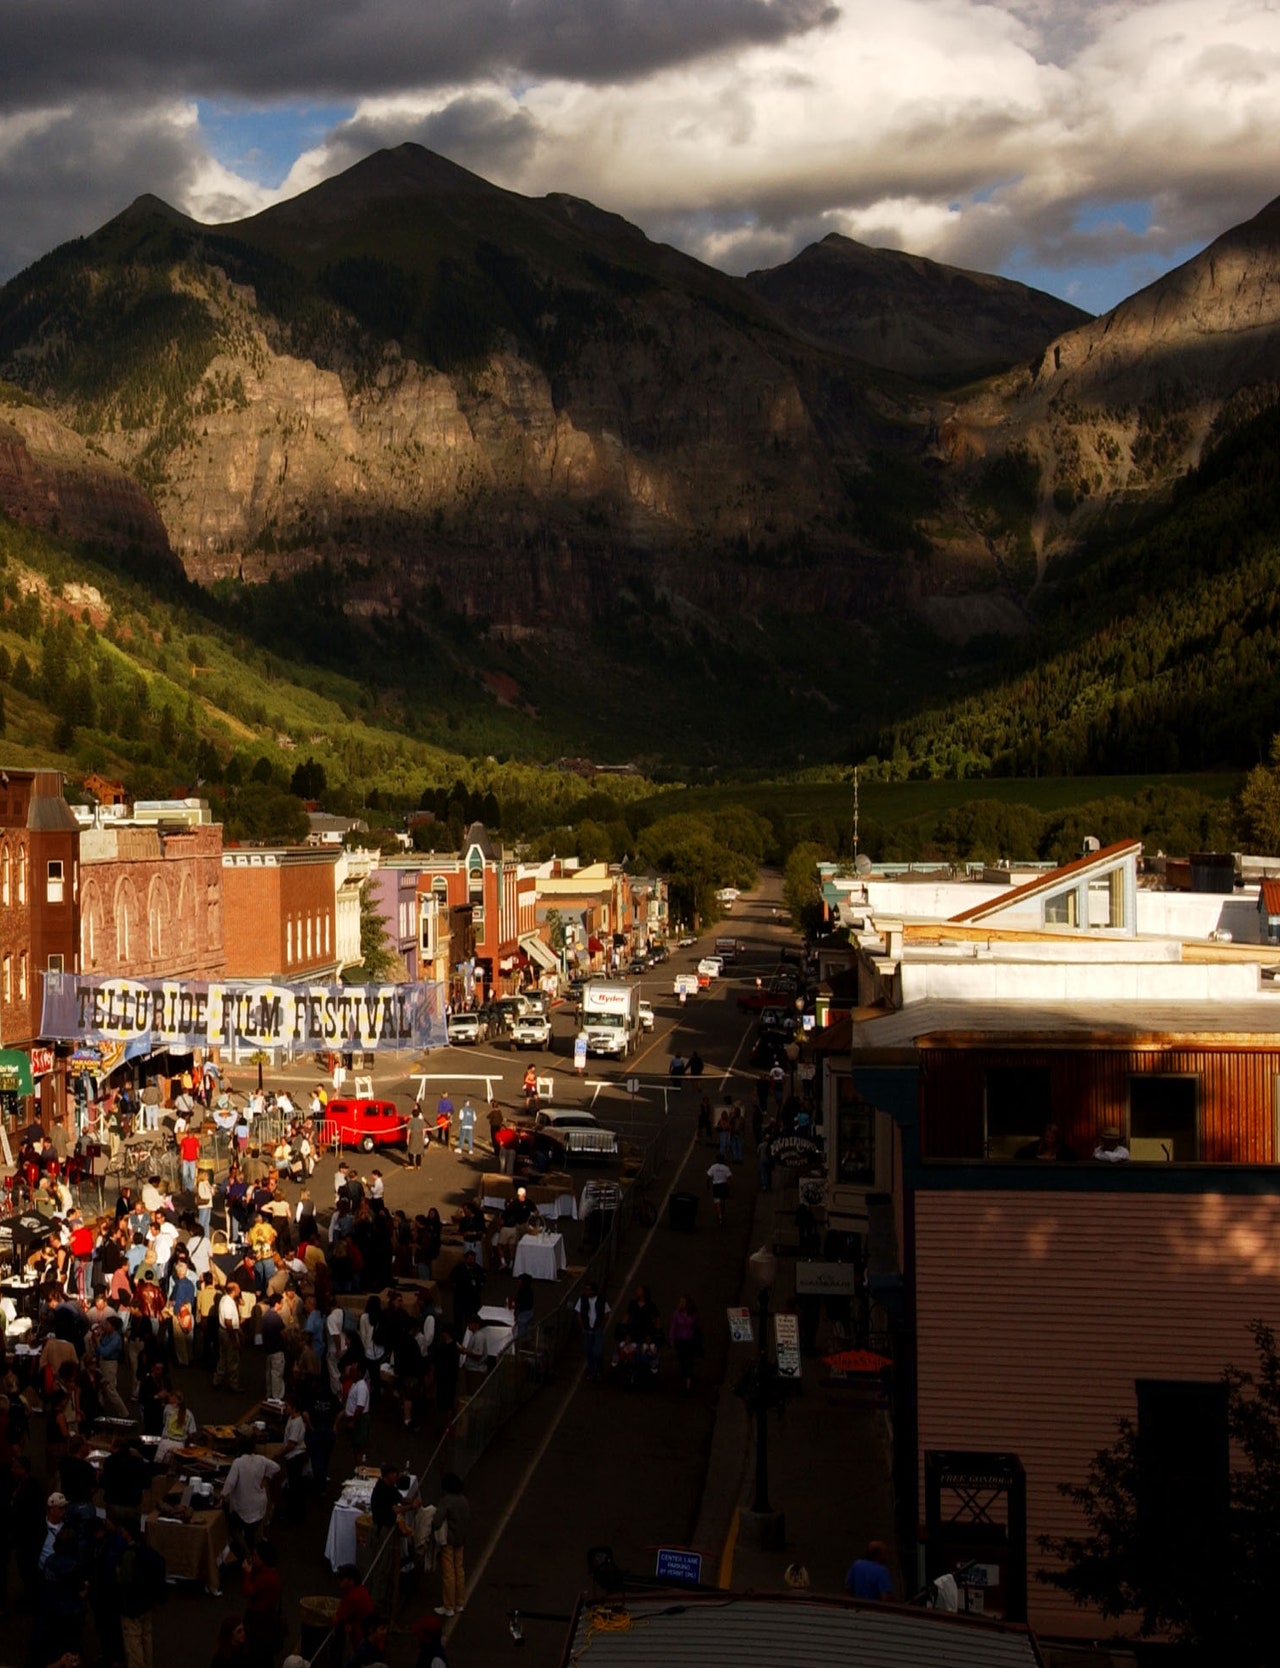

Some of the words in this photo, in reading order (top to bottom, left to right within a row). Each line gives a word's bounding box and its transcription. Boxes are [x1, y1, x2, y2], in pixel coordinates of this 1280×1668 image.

[76, 985, 209, 1036] TELLURIDE
[219, 993, 281, 1037] FILM
[293, 989, 413, 1039] FESTIVAL
[597, 994, 626, 1004] Ryder
